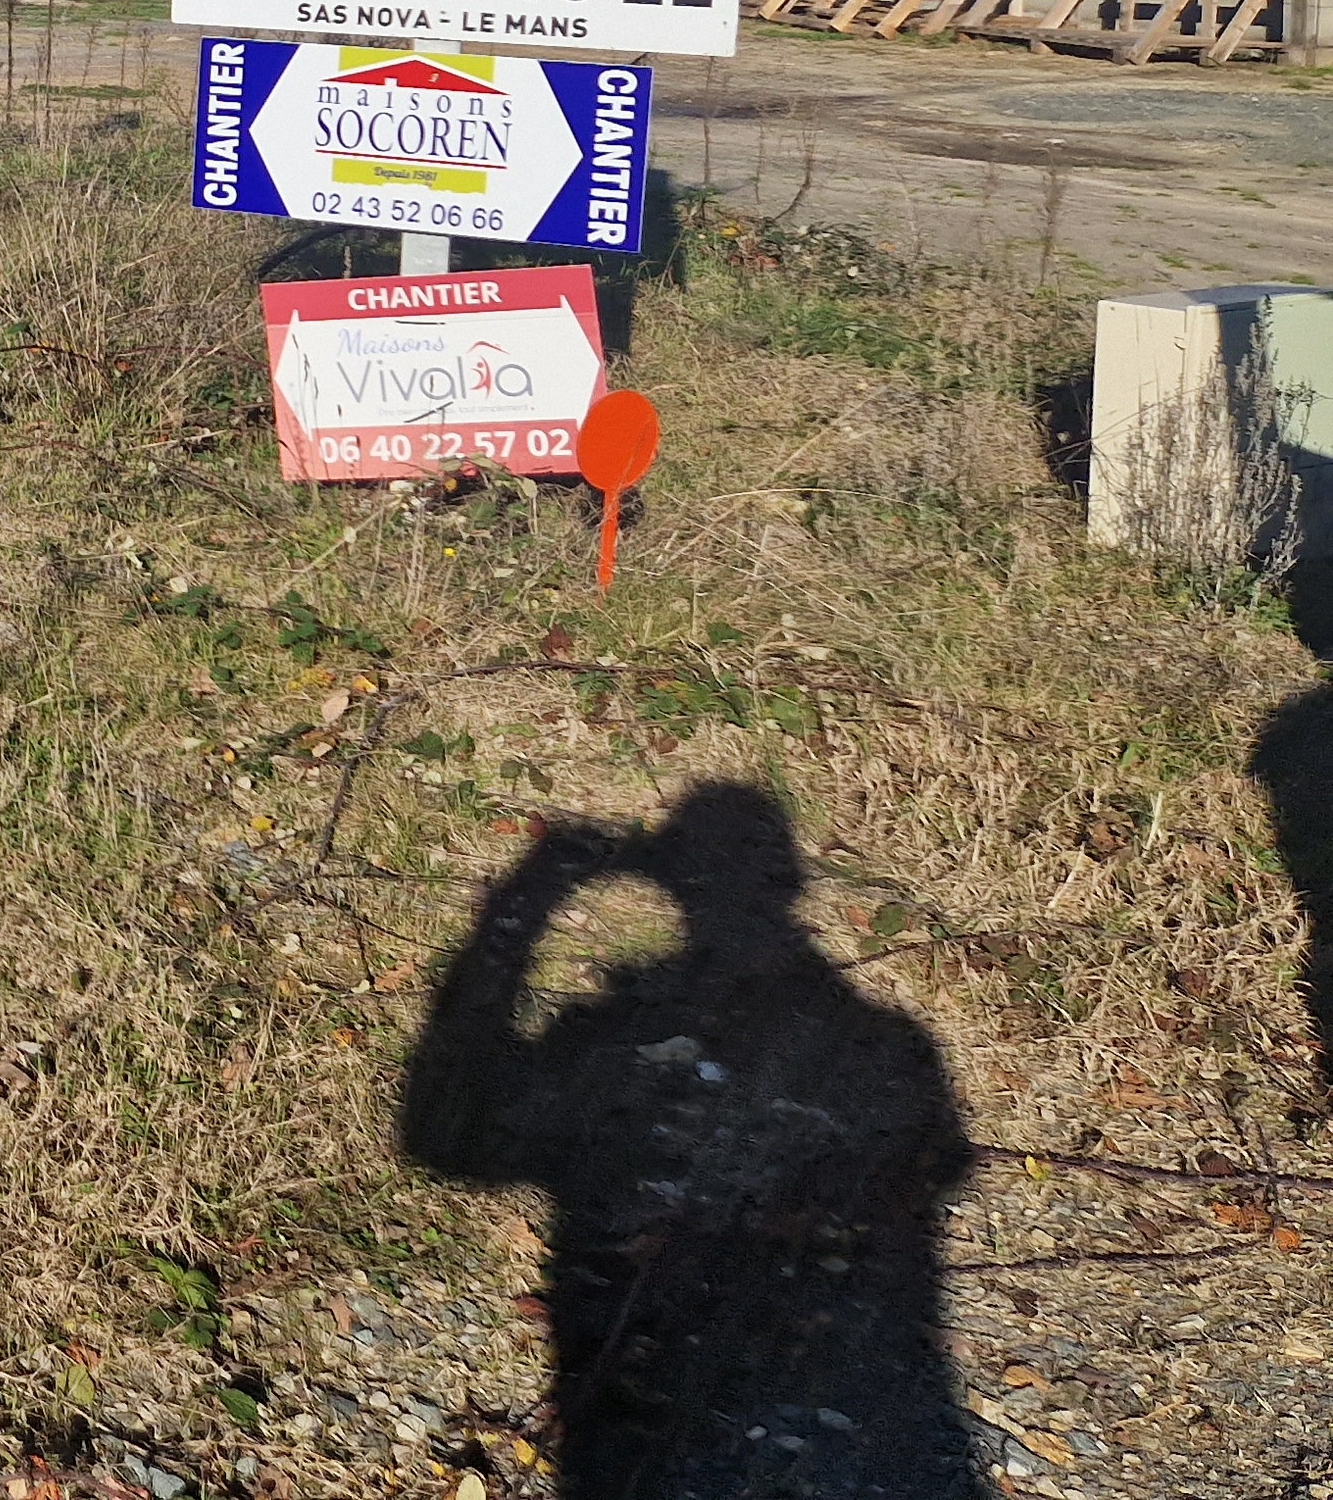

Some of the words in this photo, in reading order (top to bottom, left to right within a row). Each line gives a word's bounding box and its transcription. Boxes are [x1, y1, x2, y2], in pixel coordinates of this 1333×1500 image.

[298, 3, 346, 24] SAS
[358, 7, 430, 28] NOVA
[463, 12, 494, 32] LE
[506, 15, 587, 37] MANS
[318, 85, 510, 118] maisons
[204, 43, 244, 205] CHANTIER
[315, 108, 513, 162] SOCOREN
[587, 70, 637, 244] CHANTIER
[313, 192, 340, 214] 02
[352, 197, 379, 218] 43
[392, 200, 420, 222] 52
[432, 204, 461, 226] 06
[473, 208, 502, 230] 66
[348, 282, 502, 313] CHANTIER
[337, 328, 445, 357] Maisons
[319, 436, 360, 463] 06
[370, 435, 411, 461] 40
[421, 433, 465, 460] 22
[475, 431, 515, 457] 57
[527, 429, 572, 456] 02
